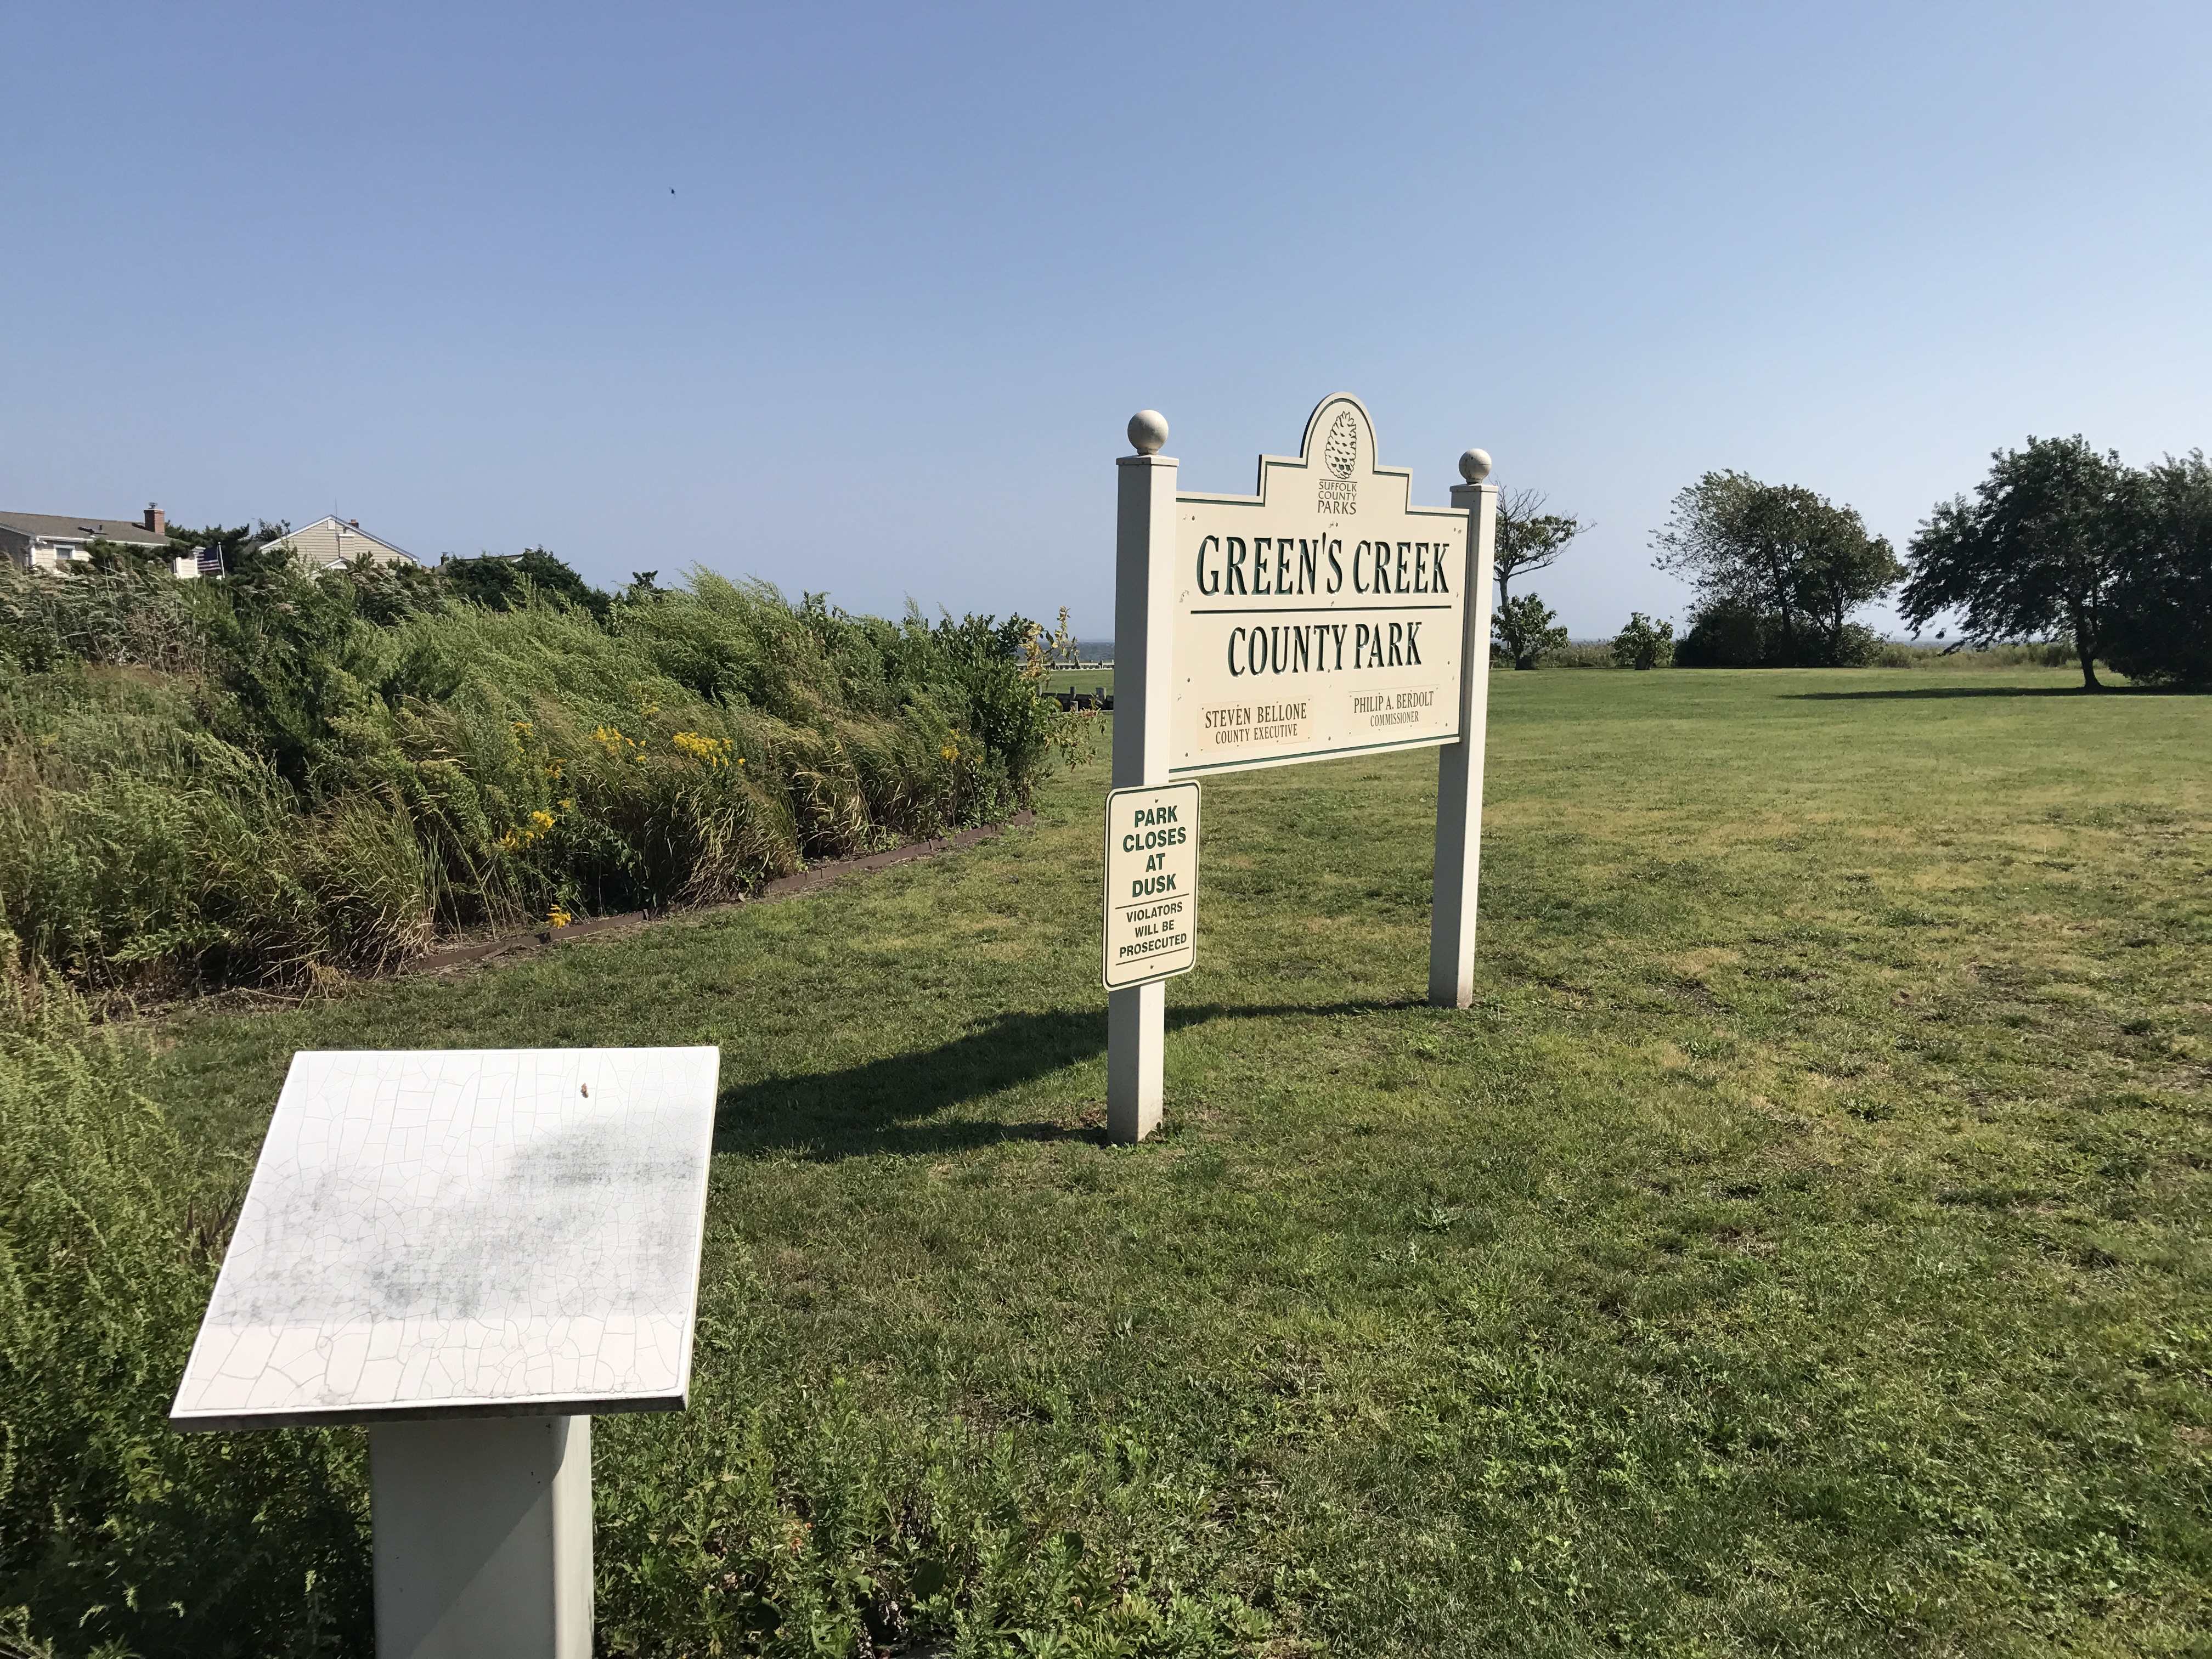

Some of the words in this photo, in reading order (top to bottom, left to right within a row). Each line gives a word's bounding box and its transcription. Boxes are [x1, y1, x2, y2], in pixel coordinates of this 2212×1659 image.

[1318, 481, 1357, 492] SUFFOLK
[1318, 490, 1357, 501] COUNTY
[1317, 500, 1357, 515] PARKS
[1196, 532, 1343, 597] GREEN'S
[1352, 539, 1450, 596] CREEK
[1227, 623, 1348, 679] COUNTY
[1353, 622, 1423, 669] PARK
[1353, 695, 1384, 714] PHILIP
[1385, 695, 1394, 710] A.
[1396, 691, 1434, 709] BERDOLT
[1205, 707, 1251, 729] STEVEN
[1257, 702, 1307, 724] BELLONE
[1370, 710, 1419, 727] COMMISSIONER
[1215, 728, 1250, 744] COUNTY
[1254, 723, 1298, 741] EXECUTIVE
[1134, 805, 1178, 828] PARK
[1122, 826, 1186, 853] CLOSES
[1145, 853, 1166, 873] AT
[1131, 873, 1176, 898] DUSK
[1126, 901, 1183, 923] VIOLATORS
[1134, 923, 1159, 939] WILL
[1161, 919, 1175, 932] BE
[1119, 933, 1187, 958] PROSECUTED
